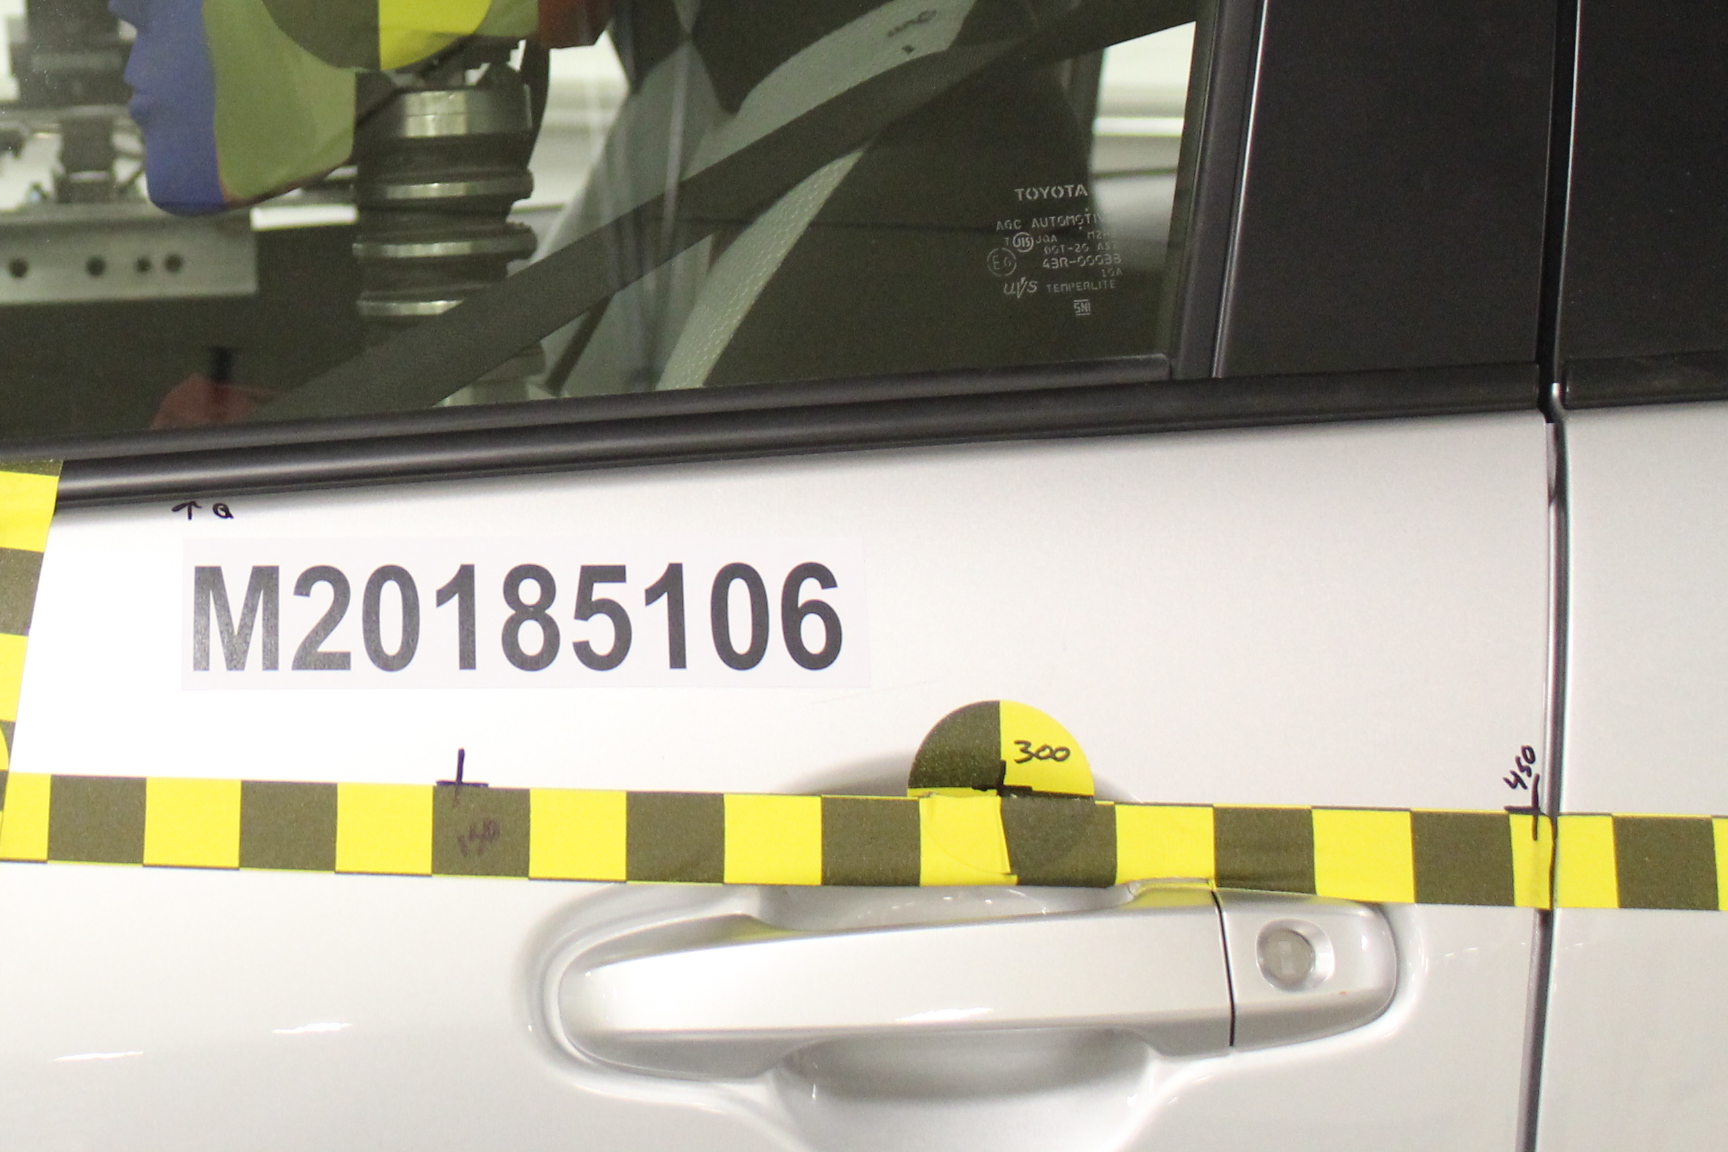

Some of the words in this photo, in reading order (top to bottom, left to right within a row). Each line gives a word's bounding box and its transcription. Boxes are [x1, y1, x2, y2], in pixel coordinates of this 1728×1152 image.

[1014, 184, 1088, 201] TOYOTA
[996, 219, 1022, 231] AGC
[1031, 213, 1107, 229] AUTOMOTIV
[192, 561, 844, 673] M20185106
[1014, 739, 1071, 764] 300
[1502, 745, 1536, 790] 450
